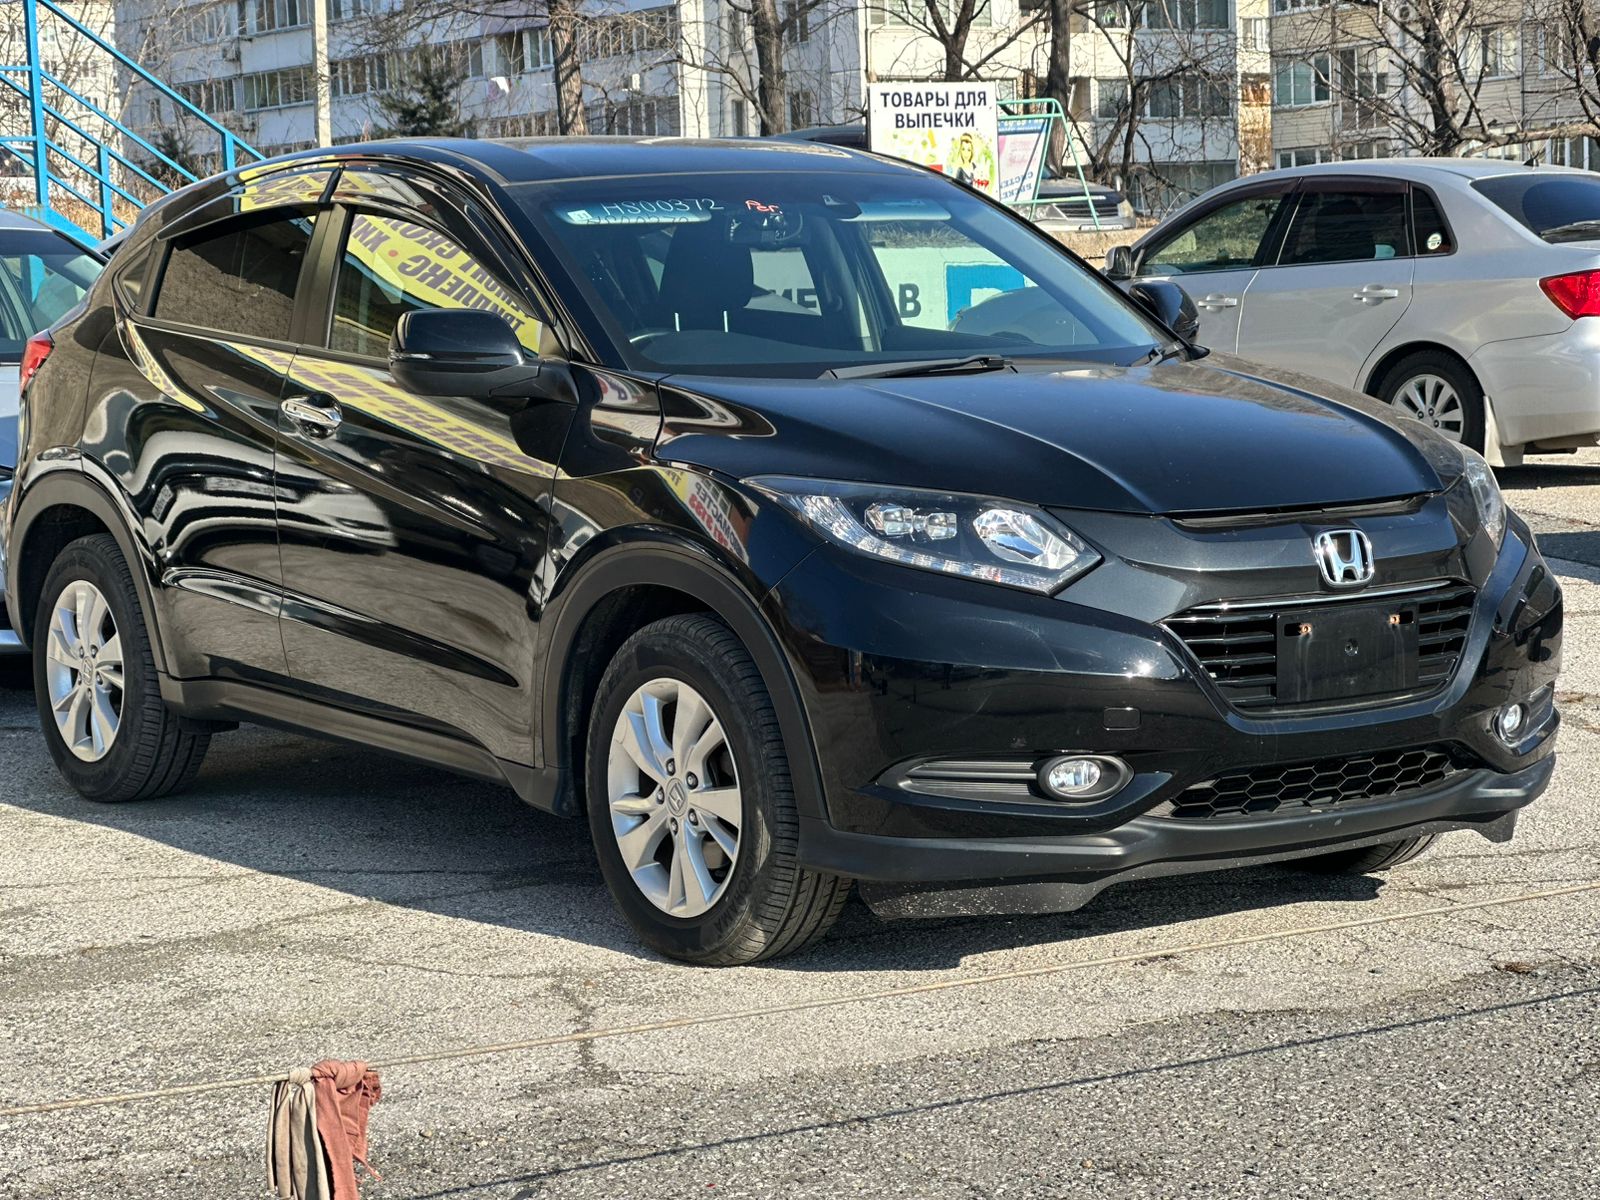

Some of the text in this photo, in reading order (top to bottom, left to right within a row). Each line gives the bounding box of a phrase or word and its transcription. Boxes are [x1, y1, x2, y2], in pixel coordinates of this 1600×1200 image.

[880, 90, 987, 109] ТОВАРЫ ДЛЯ
[895, 111, 975, 129] ВЫПЕЧКИ
[601, 198, 724, 216] HS00372
